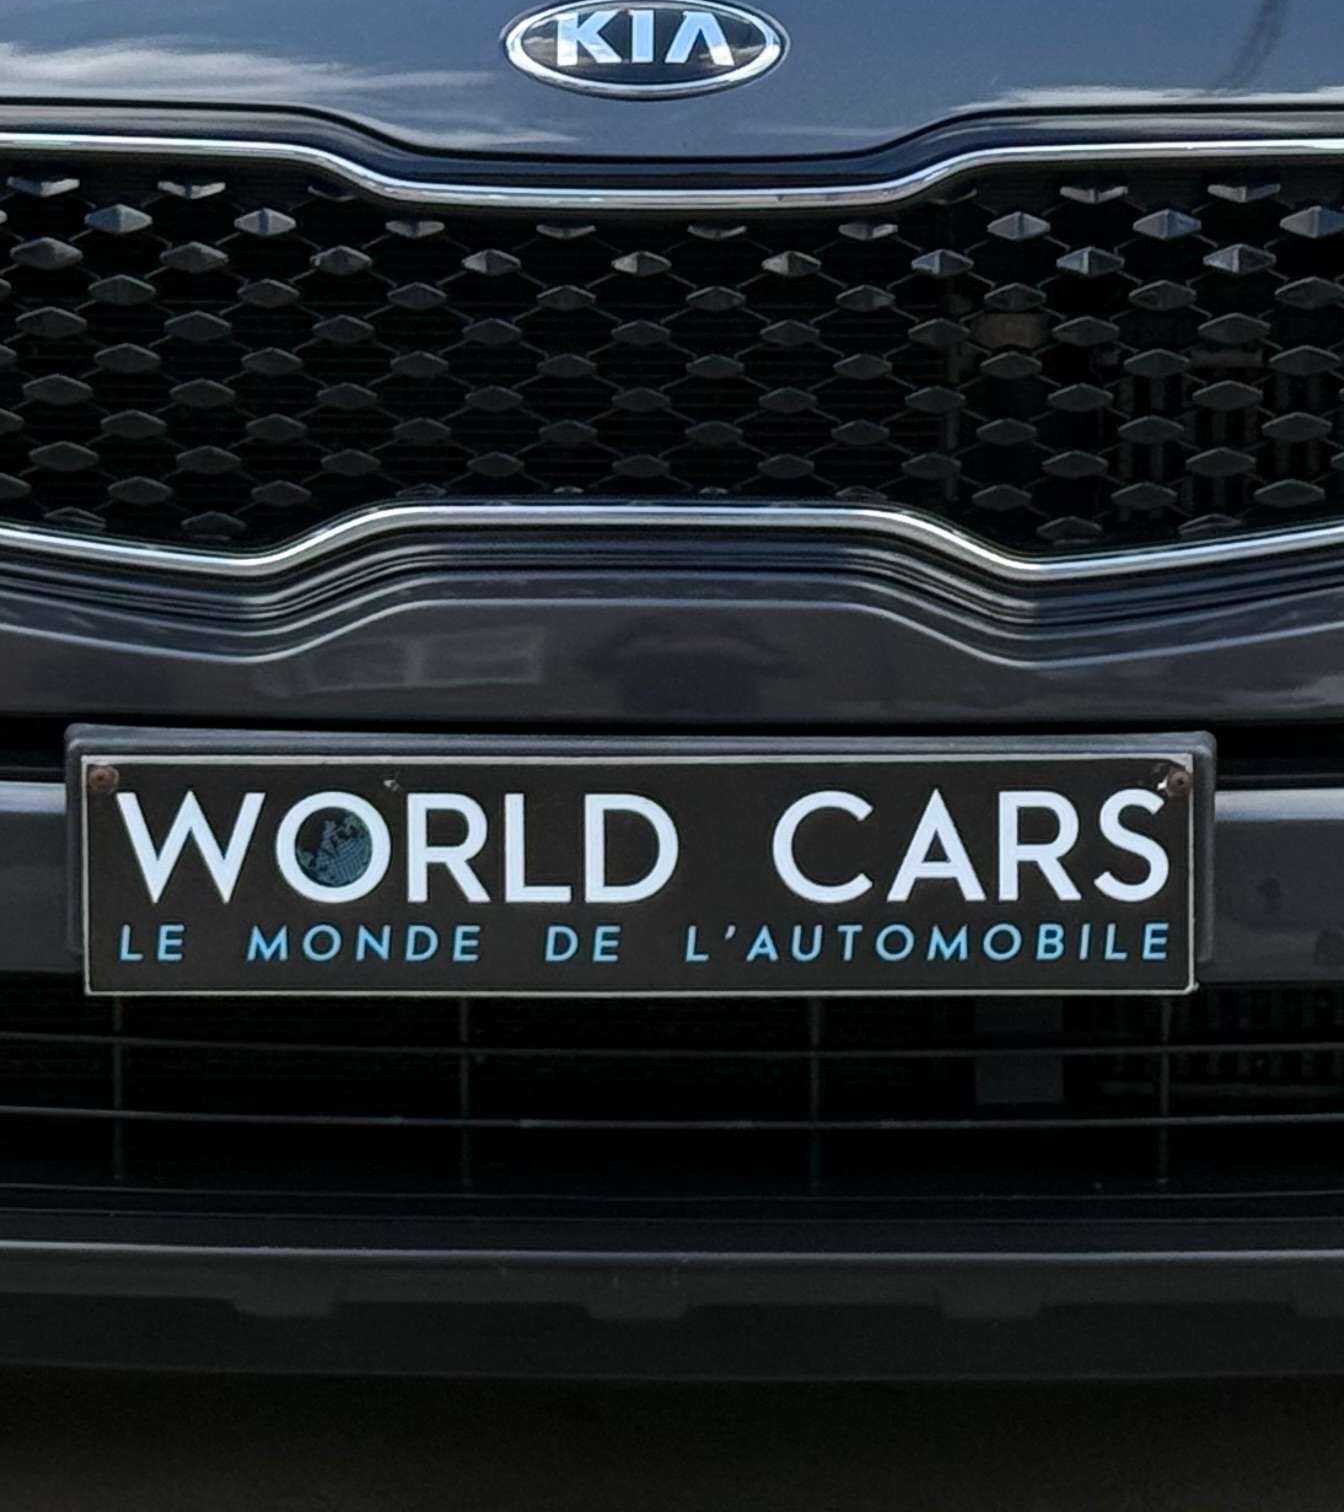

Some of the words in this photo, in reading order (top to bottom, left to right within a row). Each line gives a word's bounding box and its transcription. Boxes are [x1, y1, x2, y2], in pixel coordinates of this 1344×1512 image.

[557, 8, 735, 66] KIA
[115, 789, 679, 904] WORLD
[772, 788, 1170, 904] CARS
[119, 924, 186, 963] LE
[246, 924, 481, 963] MONDE
[544, 924, 621, 963] DE
[685, 922, 1170, 963] L'AUTOMOBILE
